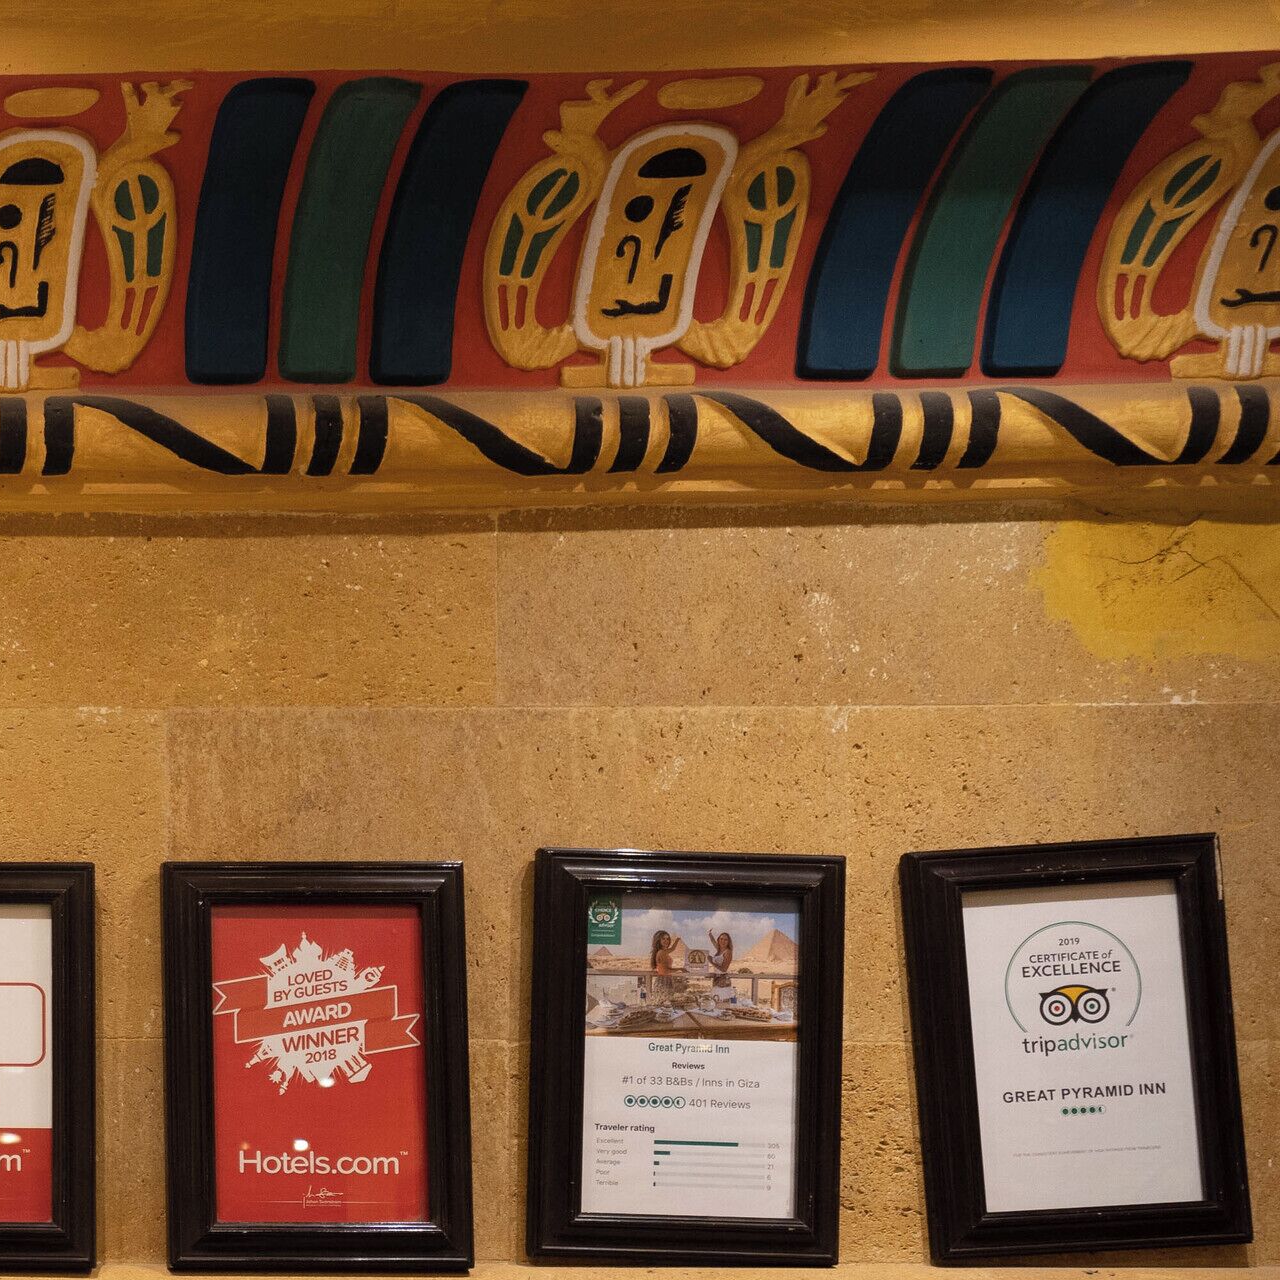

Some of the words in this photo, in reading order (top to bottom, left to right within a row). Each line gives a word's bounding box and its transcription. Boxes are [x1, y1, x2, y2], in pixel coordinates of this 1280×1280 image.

[1058, 937, 1080, 946] 2019
[1029, 950, 1099, 964] CERTIFICATE
[1101, 949, 1113, 960] of
[1022, 960, 1122, 979] EXCELLENCE
[287, 969, 334, 987] LOVED
[273, 988, 294, 1003] BY
[294, 980, 348, 1000] GUESTS
[282, 1002, 353, 1028] AWARD
[280, 1026, 360, 1054] WINNER
[1022, 1032, 1128, 1057] tripadvisor
[305, 1048, 337, 1064] 2018
[648, 1043, 674, 1052] Great
[715, 1044, 730, 1054] Inn
[672, 1062, 706, 1070] Reviews
[622, 1076, 634, 1086] #1
[636, 1076, 647, 1086] of
[649, 1076, 663, 1086] 33
[666, 1077, 693, 1087] B&Bs
[702, 1077, 723, 1088] Inns
[726, 1078, 735, 1088] in
[738, 1078, 760, 1089] Giza
[1002, 1088, 1056, 1104] GREAT
[1060, 1084, 1134, 1100] PYRAMID
[1138, 1082, 1166, 1096] INN
[689, 1098, 708, 1108] 401
[710, 1099, 751, 1110] Reviews
[595, 1124, 628, 1132] Traveler
[630, 1125, 655, 1133] rating
